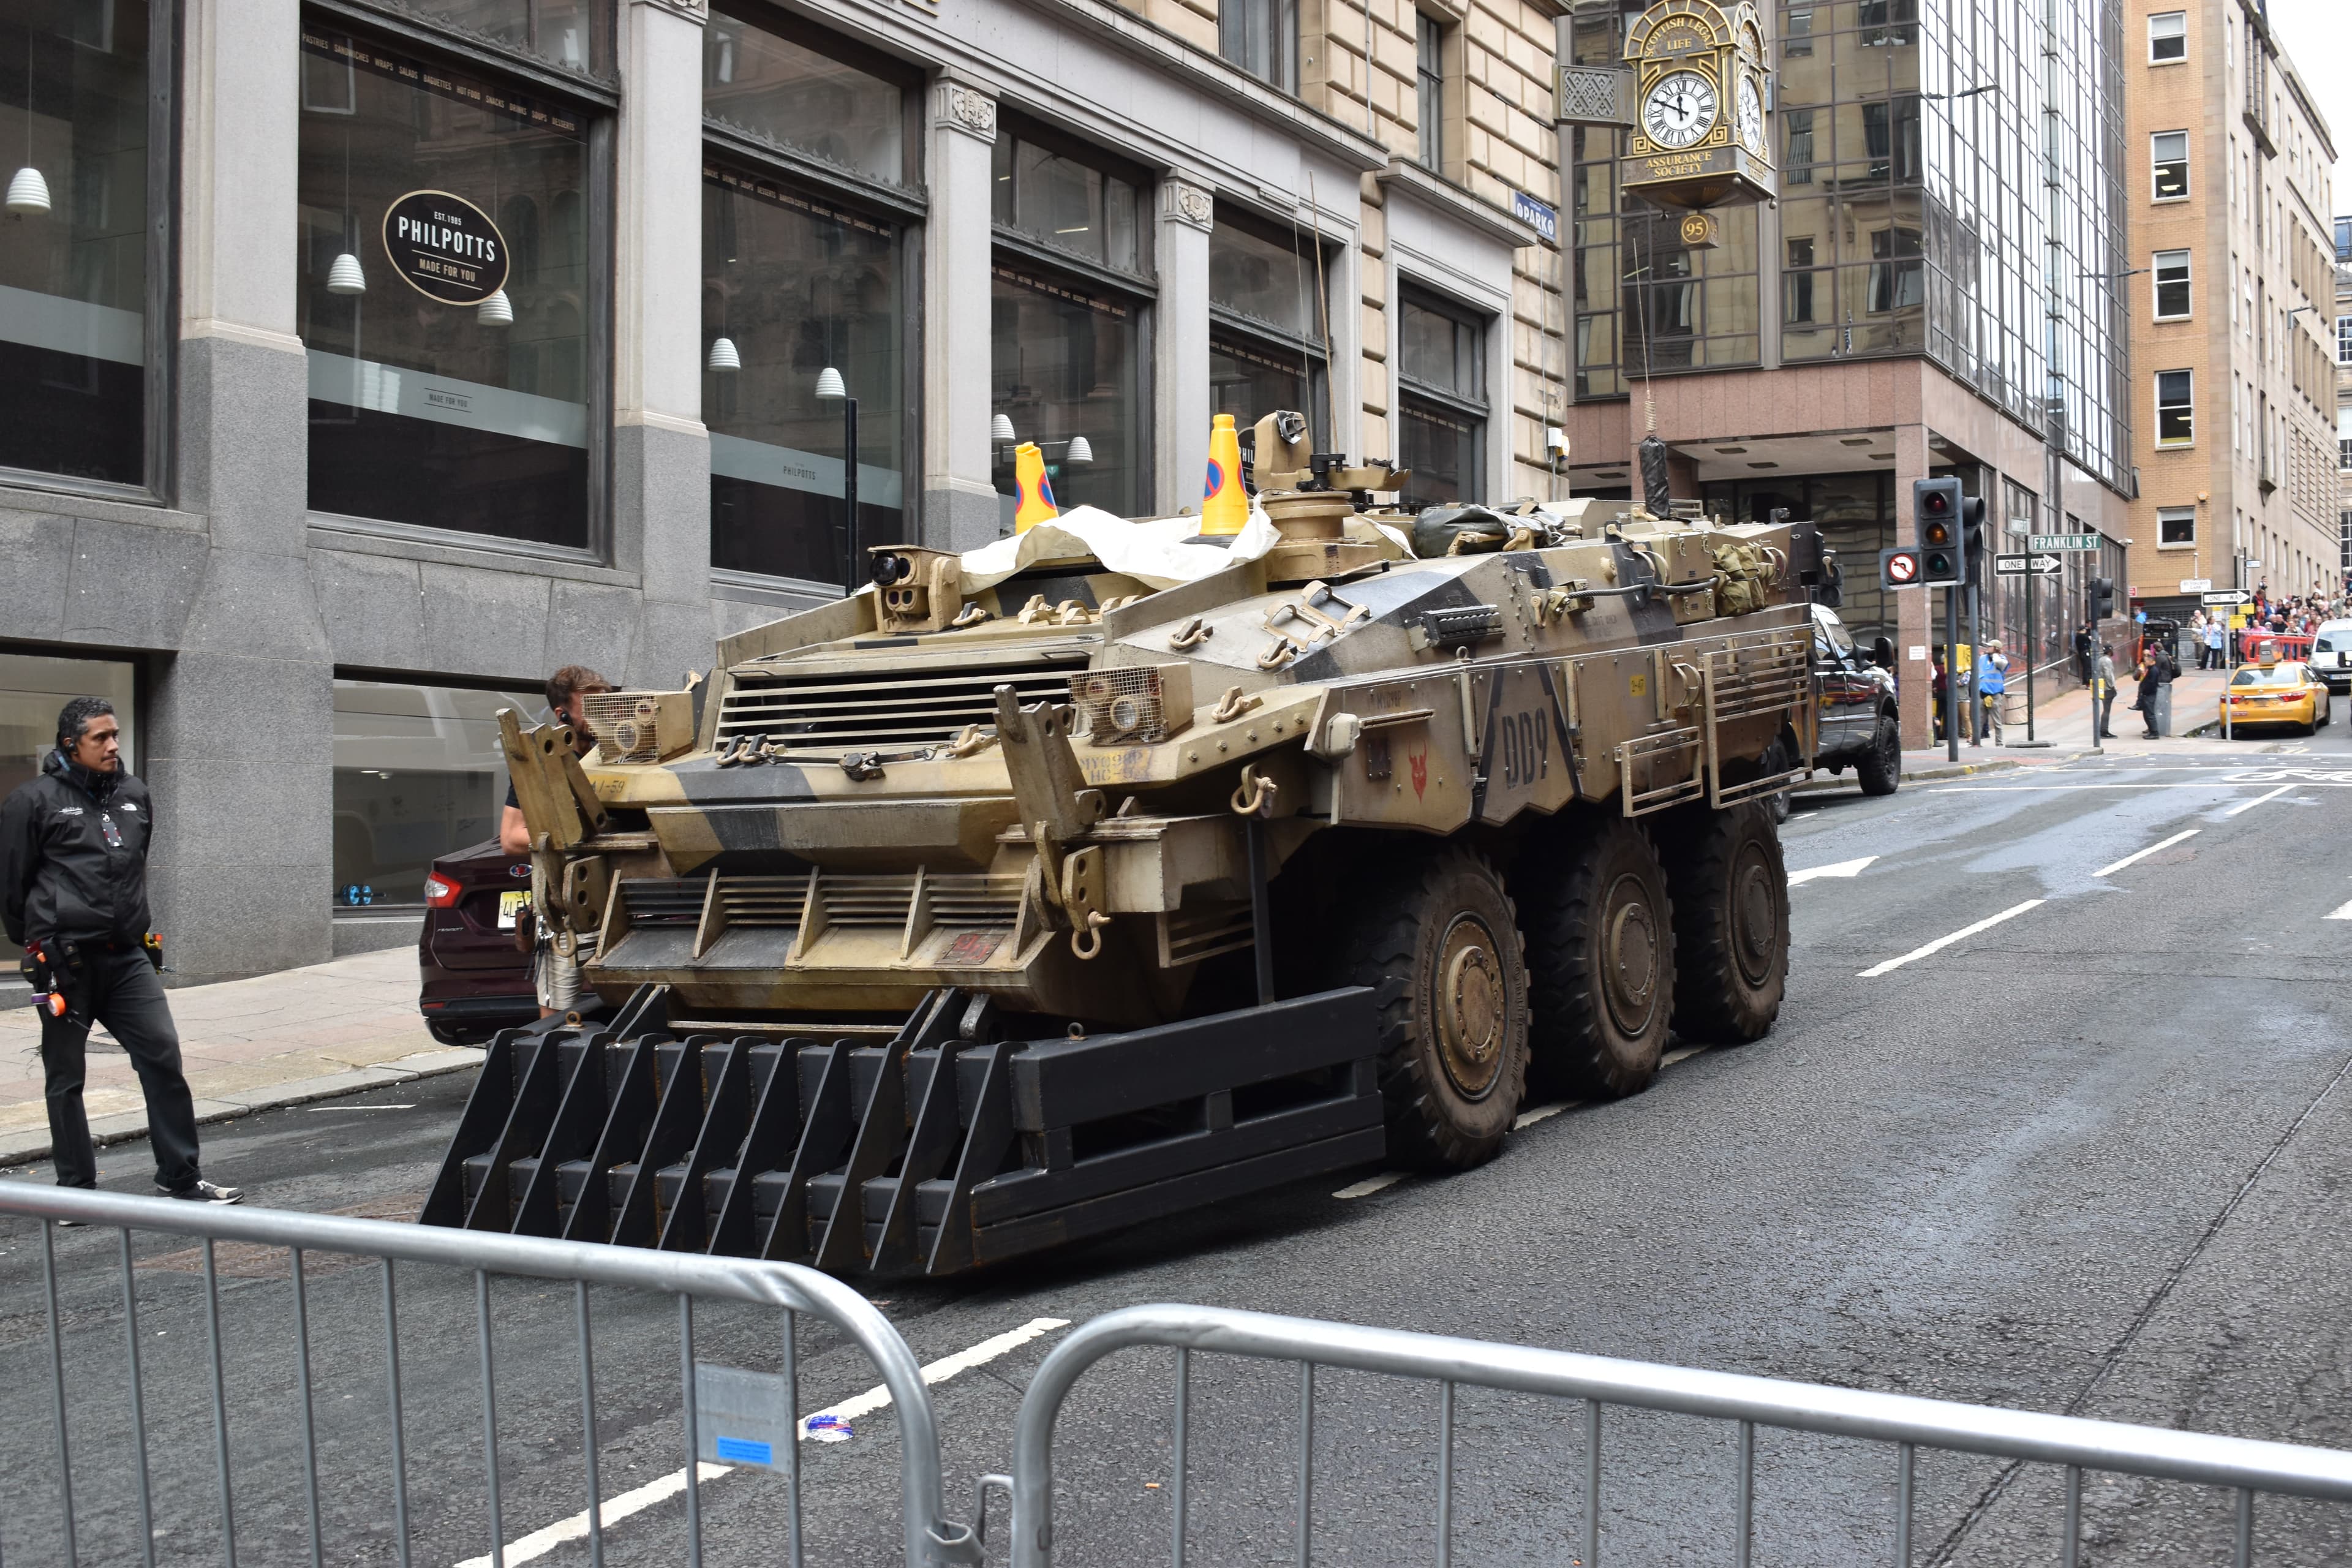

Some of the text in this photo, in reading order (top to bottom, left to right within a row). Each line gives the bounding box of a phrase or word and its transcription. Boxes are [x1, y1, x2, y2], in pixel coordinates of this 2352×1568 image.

[1645, 18, 1714, 57] SCOTTISH LEGAL
[1667, 38, 1692, 51] LIFE
[303, 33, 328, 49] PASTRIES
[374, 58, 393, 71] WRAPS
[485, 95, 505, 108] SNACKS
[1646, 151, 1712, 168] ASSURANCE
[1655, 162, 1703, 178] SOCIETY
[1686, 222, 1703, 236] 95
[399, 216, 495, 262] PHILPOTTS
[419, 258, 475, 282] MADE FOR YOU
[783, 466, 816, 480] PHILPOTTS
[2034, 536, 2098, 549] FRANKLIN ST
[2005, 559, 2051, 569] ONE WAY
[1502, 707, 1548, 790] DD9
